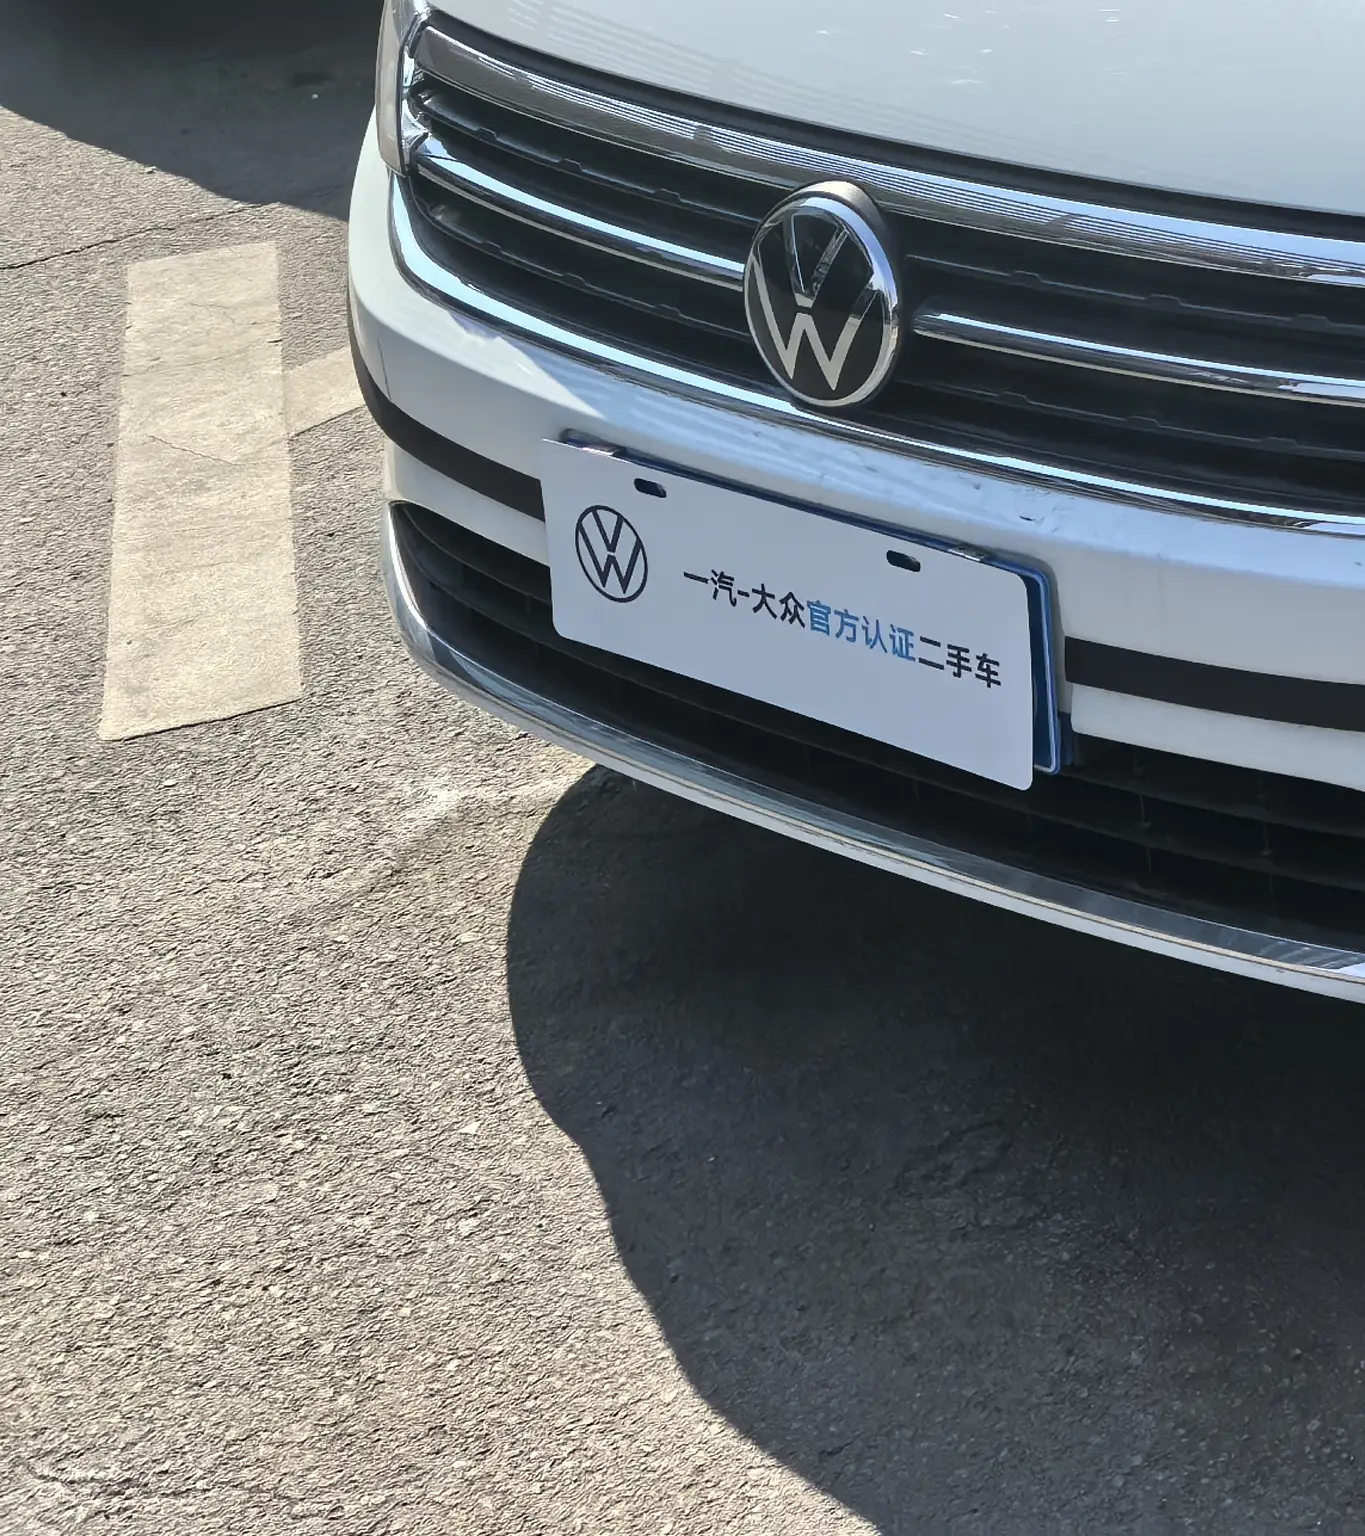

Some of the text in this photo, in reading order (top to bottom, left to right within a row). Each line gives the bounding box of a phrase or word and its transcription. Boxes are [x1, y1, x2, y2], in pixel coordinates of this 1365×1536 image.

[683, 569, 1002, 689] 一汽-大众官方认证二手车
